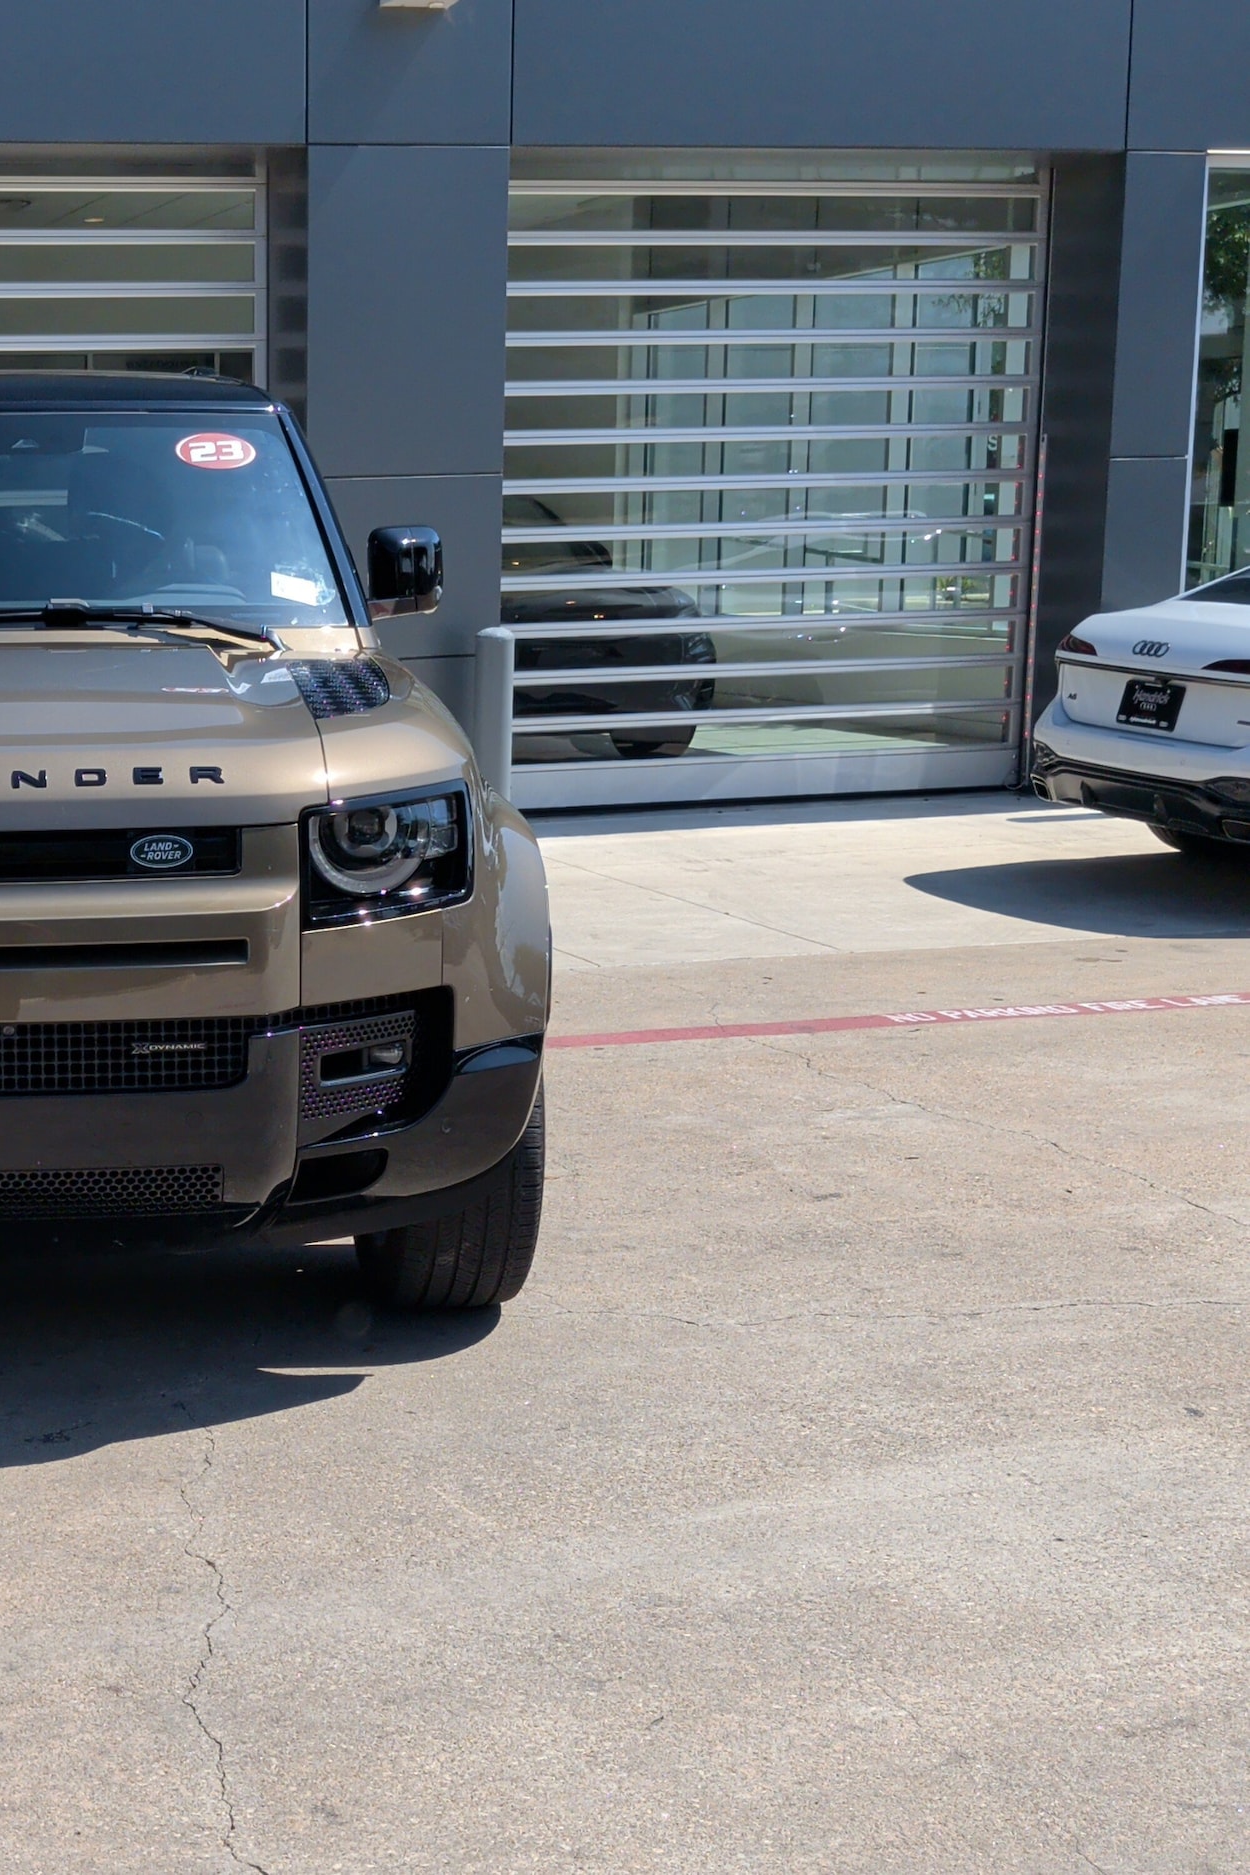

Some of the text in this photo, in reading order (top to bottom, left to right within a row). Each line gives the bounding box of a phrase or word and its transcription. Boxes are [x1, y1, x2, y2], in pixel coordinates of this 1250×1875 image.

[188, 440, 245, 463] 23
[144, 842, 173, 851] LAND
[146, 851, 181, 860] ROVER
[884, 994, 1250, 1024] NO PARKING FIRE LANE
